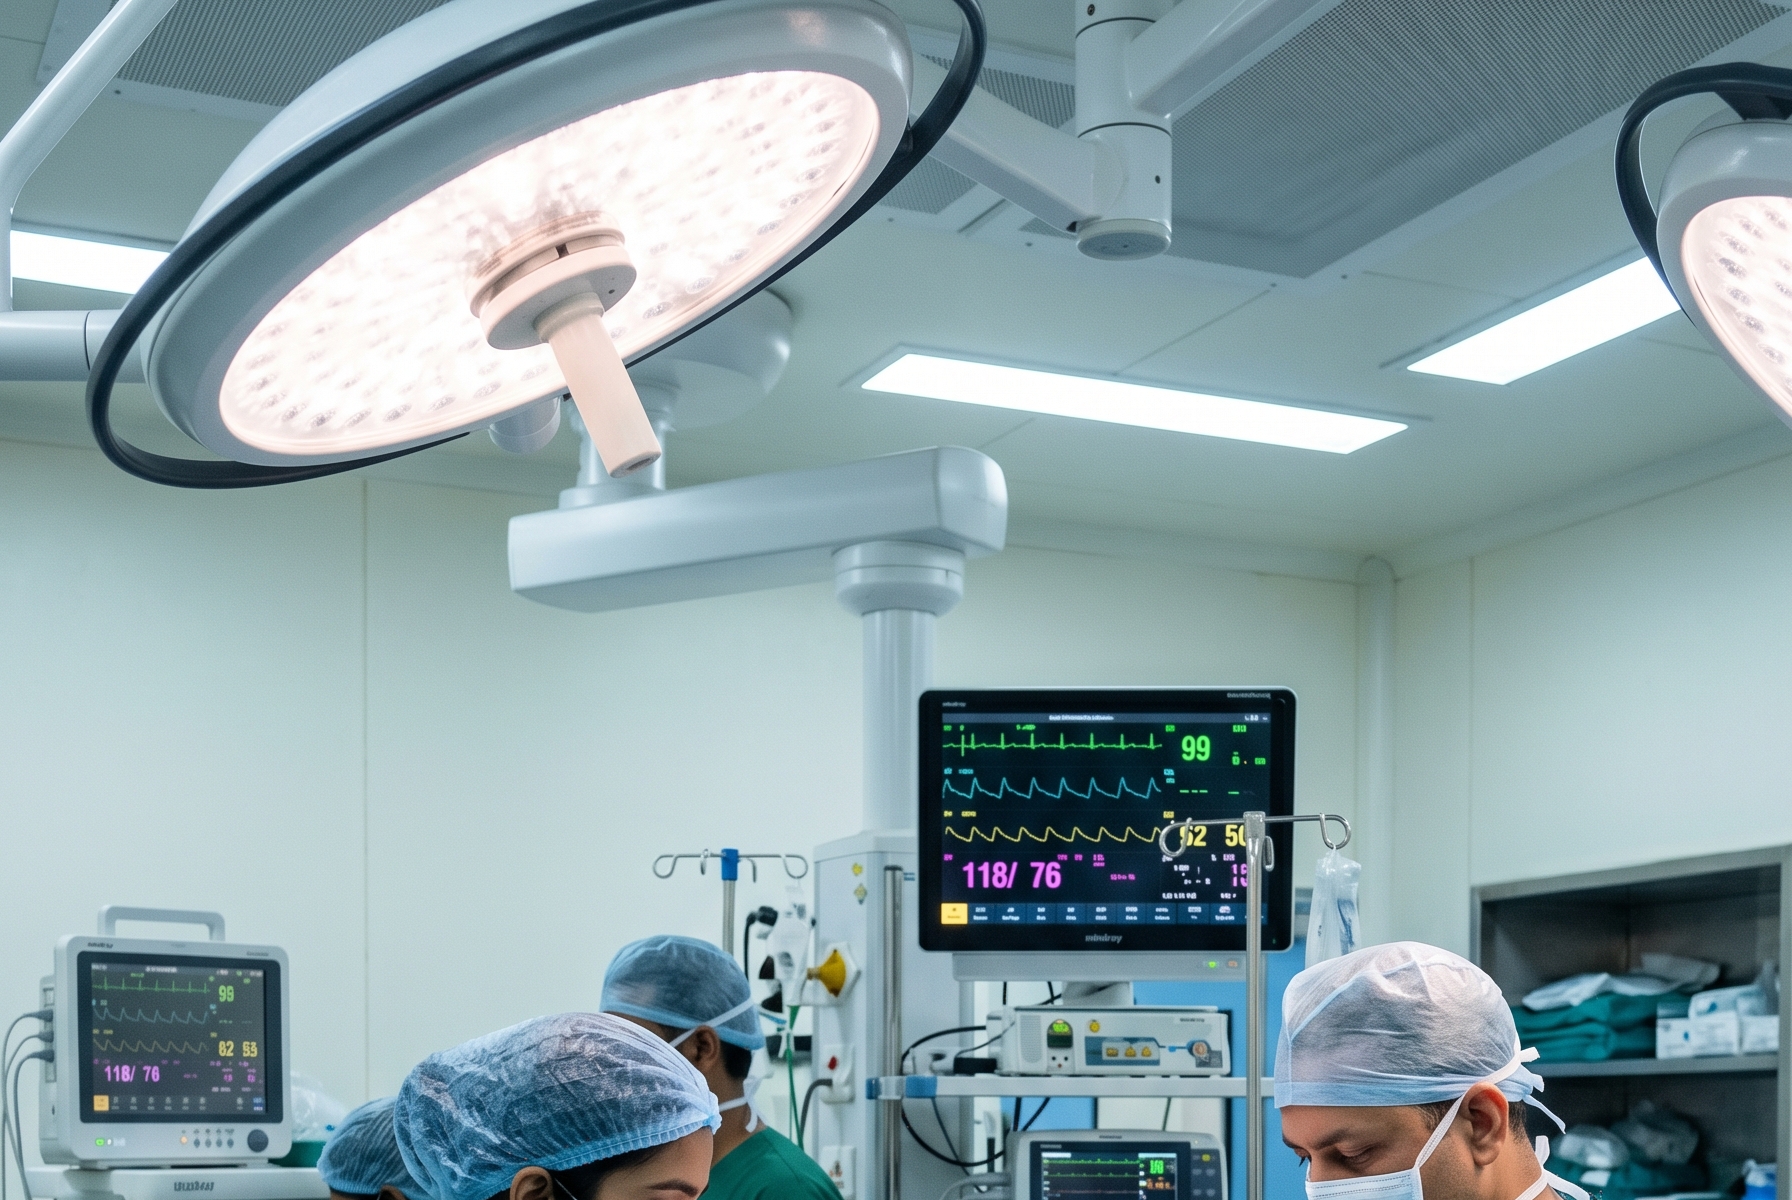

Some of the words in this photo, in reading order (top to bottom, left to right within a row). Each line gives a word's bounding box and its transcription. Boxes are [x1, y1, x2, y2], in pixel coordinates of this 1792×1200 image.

[1181, 735, 1211, 762] 99
[962, 861, 1018, 889] 118/
[1030, 861, 1062, 889] 76
